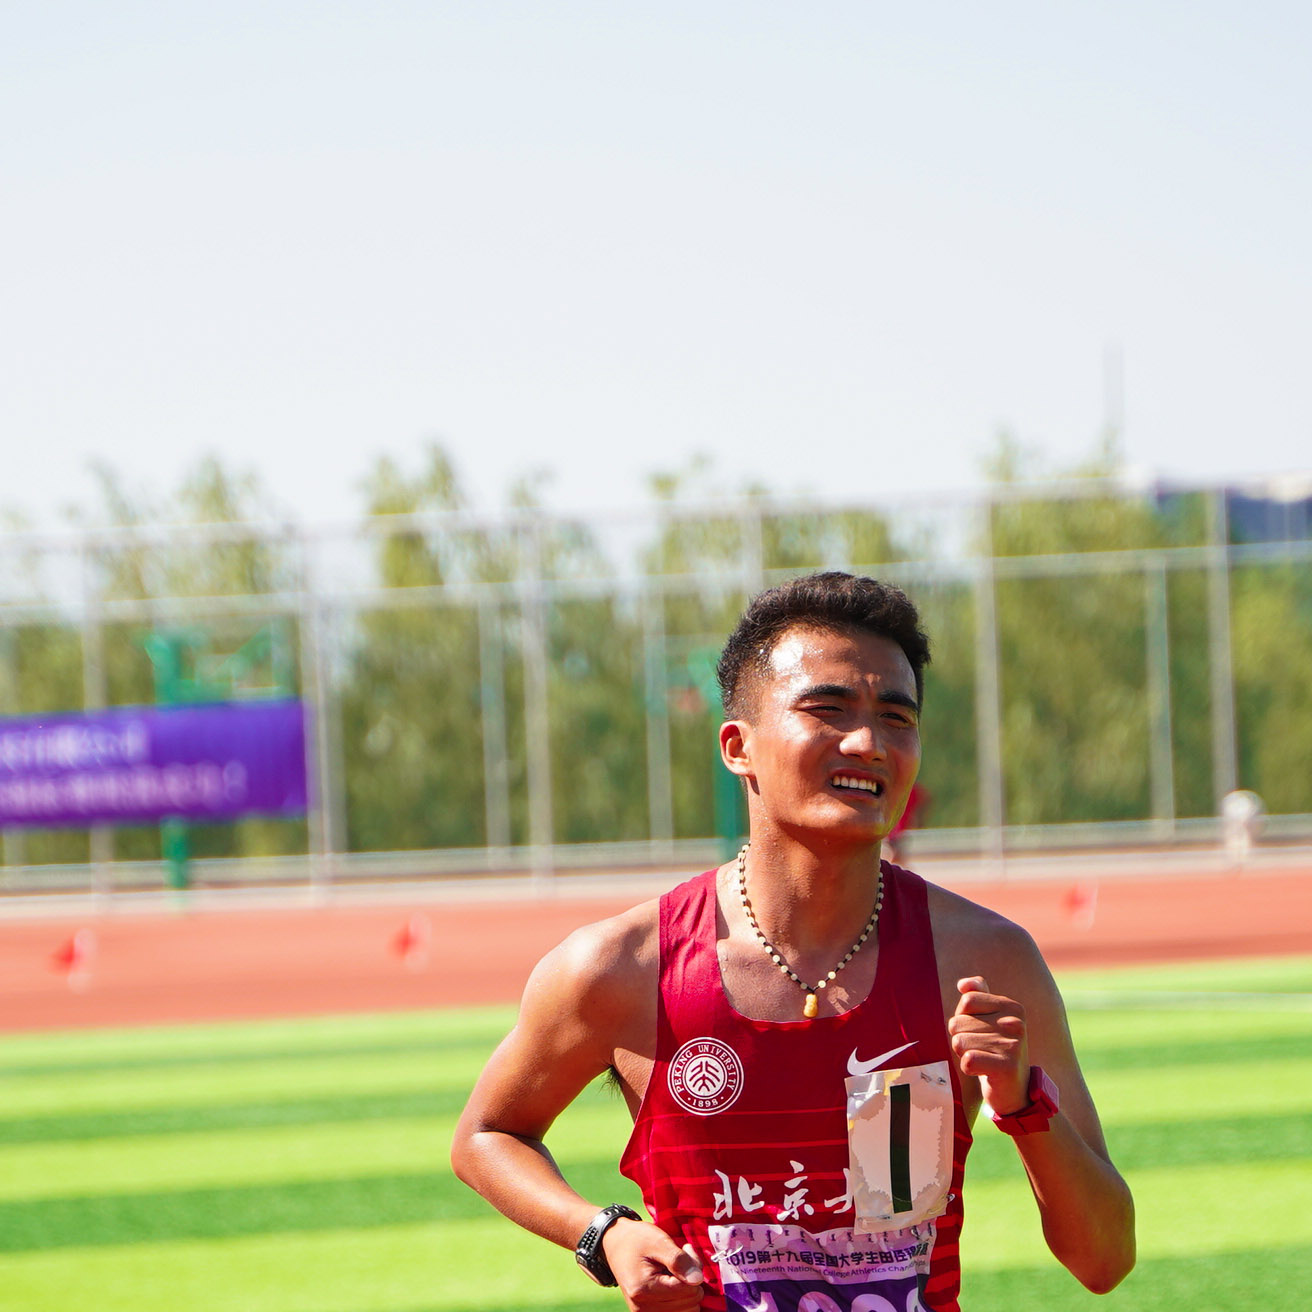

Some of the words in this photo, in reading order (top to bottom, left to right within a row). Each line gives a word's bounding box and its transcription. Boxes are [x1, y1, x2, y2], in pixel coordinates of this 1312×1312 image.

[674, 1049, 693, 1093] PEKING
[697, 1044, 737, 1091] UNIVERSITY
[692, 1098, 719, 1108] 1898
[851, 1265, 887, 1276] Athletics
